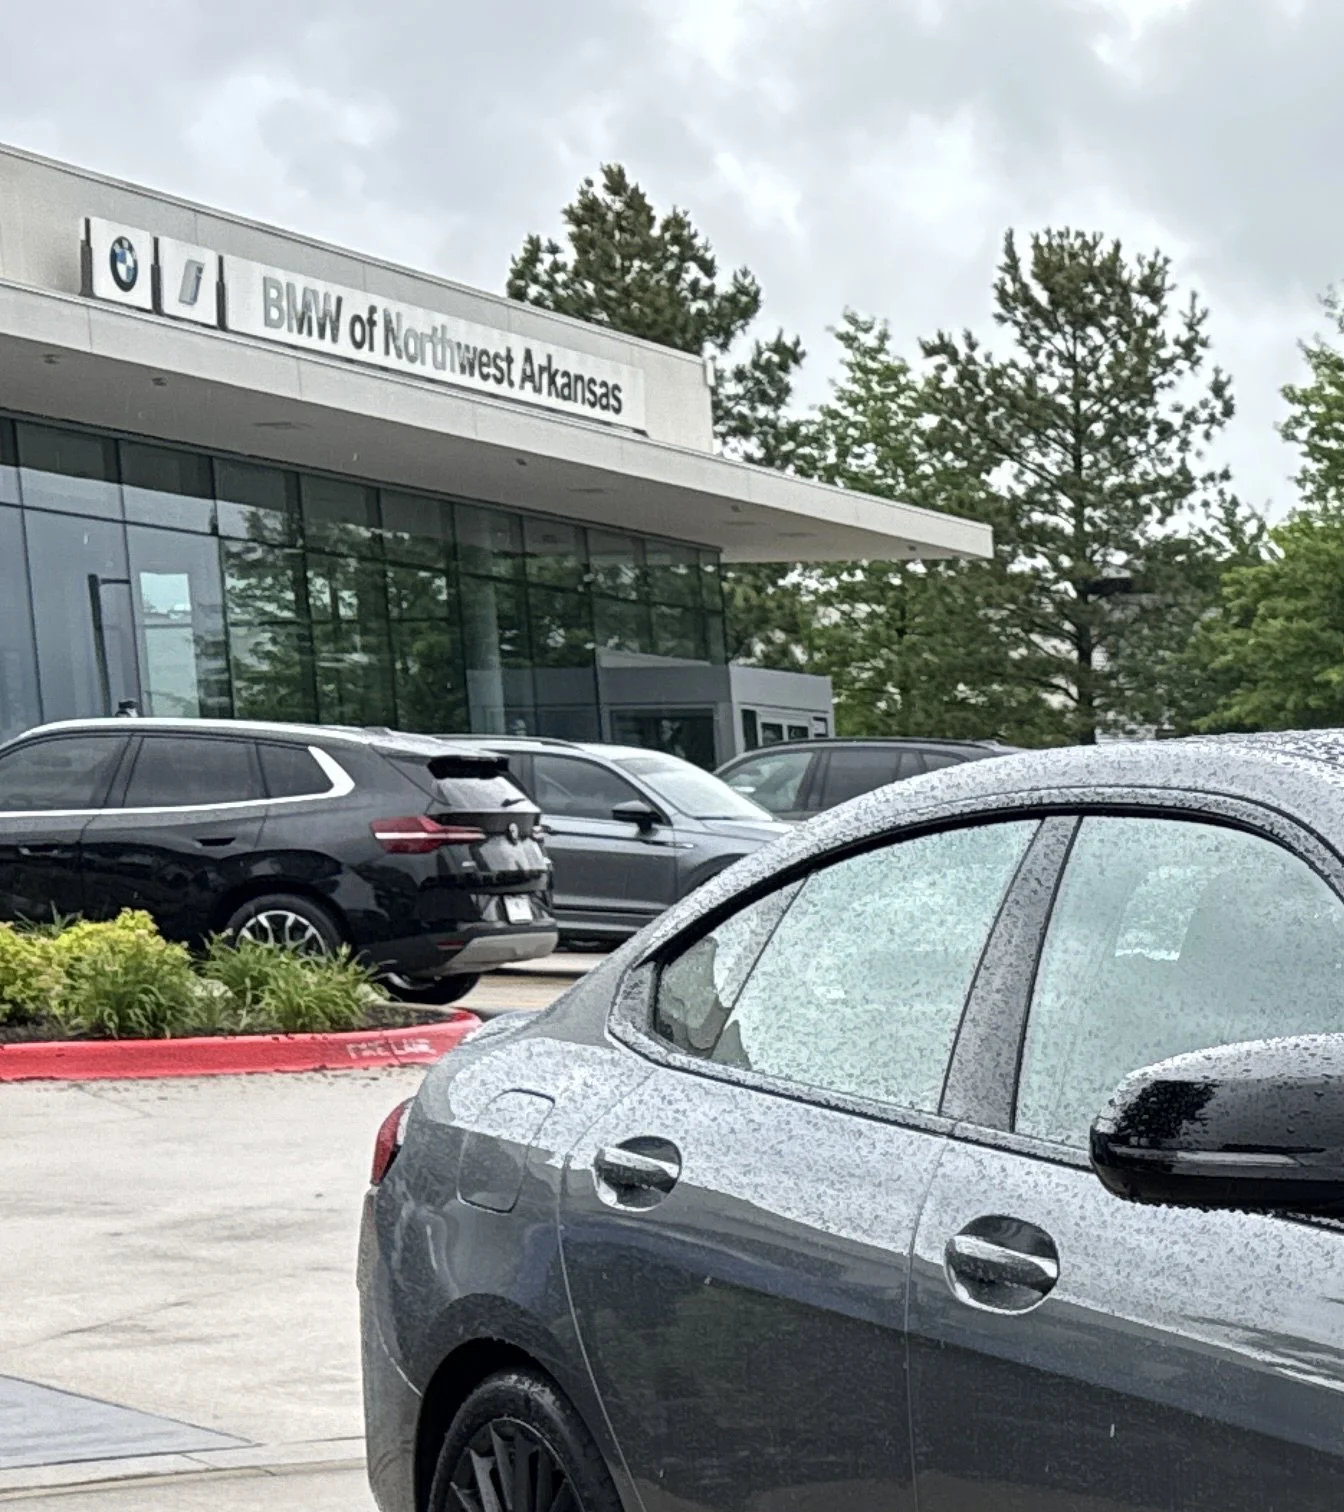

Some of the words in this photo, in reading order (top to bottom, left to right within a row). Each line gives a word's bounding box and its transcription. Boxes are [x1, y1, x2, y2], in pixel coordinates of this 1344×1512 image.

[263, 275, 343, 344] BMW
[350, 304, 377, 352] of
[383, 307, 515, 389] Northwest
[519, 347, 623, 415] Arkansas
